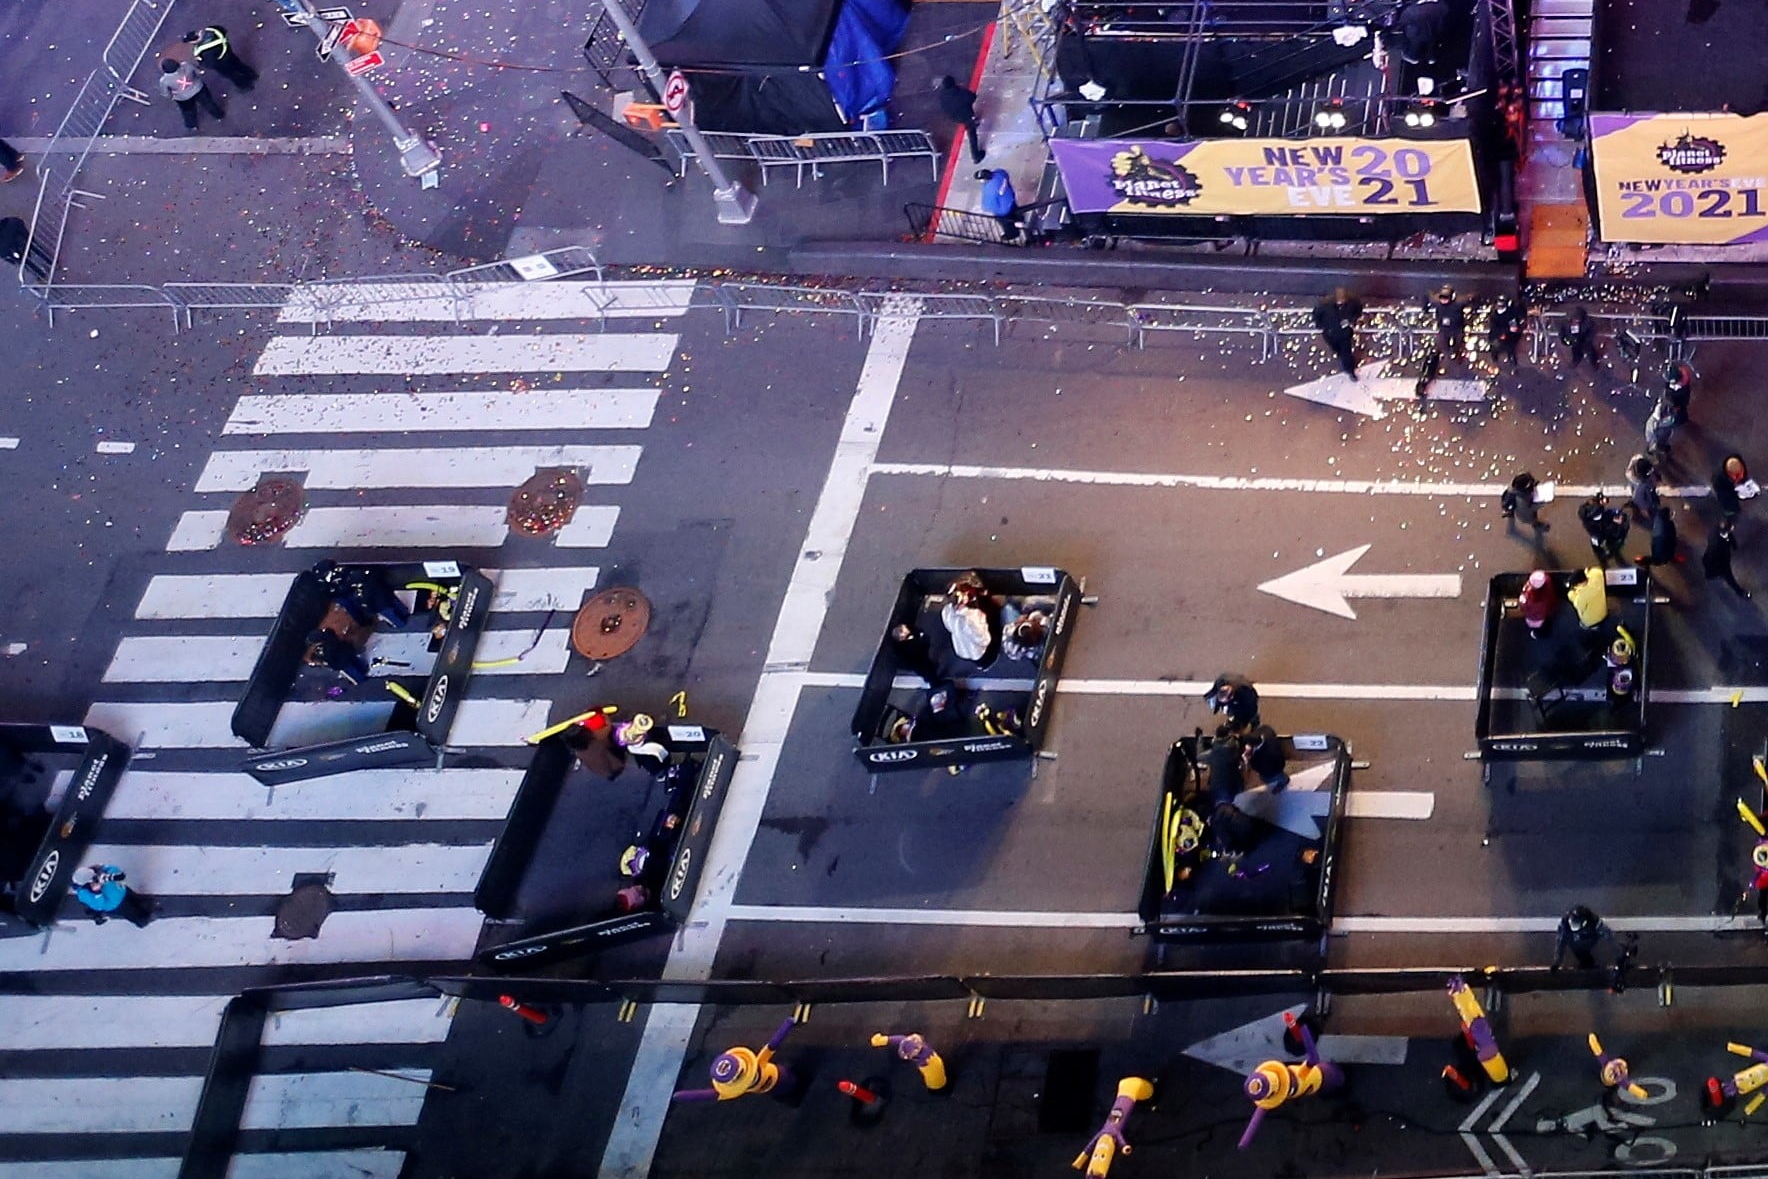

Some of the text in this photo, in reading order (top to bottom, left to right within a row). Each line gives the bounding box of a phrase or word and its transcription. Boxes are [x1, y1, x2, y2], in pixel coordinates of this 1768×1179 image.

[1264, 146, 1343, 167] NEW
[1351, 145, 1432, 179] 20
[1662, 148, 1710, 161] planet
[1669, 155, 1721, 165] fitness
[1114, 177, 1181, 193] planet
[1224, 166, 1351, 187] YEAR'S
[1127, 187, 1197, 201] fitness
[1286, 185, 1354, 207] EVE
[1358, 177, 1439, 206] 21
[1620, 189, 1766, 218] 2021
[429, 679, 447, 719] KIA
[1032, 684, 1046, 723] KIA
[259, 760, 305, 769] KIA
[873, 751, 915, 762] KIA
[32, 854, 57, 898] KIA
[672, 852, 689, 896] KIA
[498, 947, 545, 959] KIA
